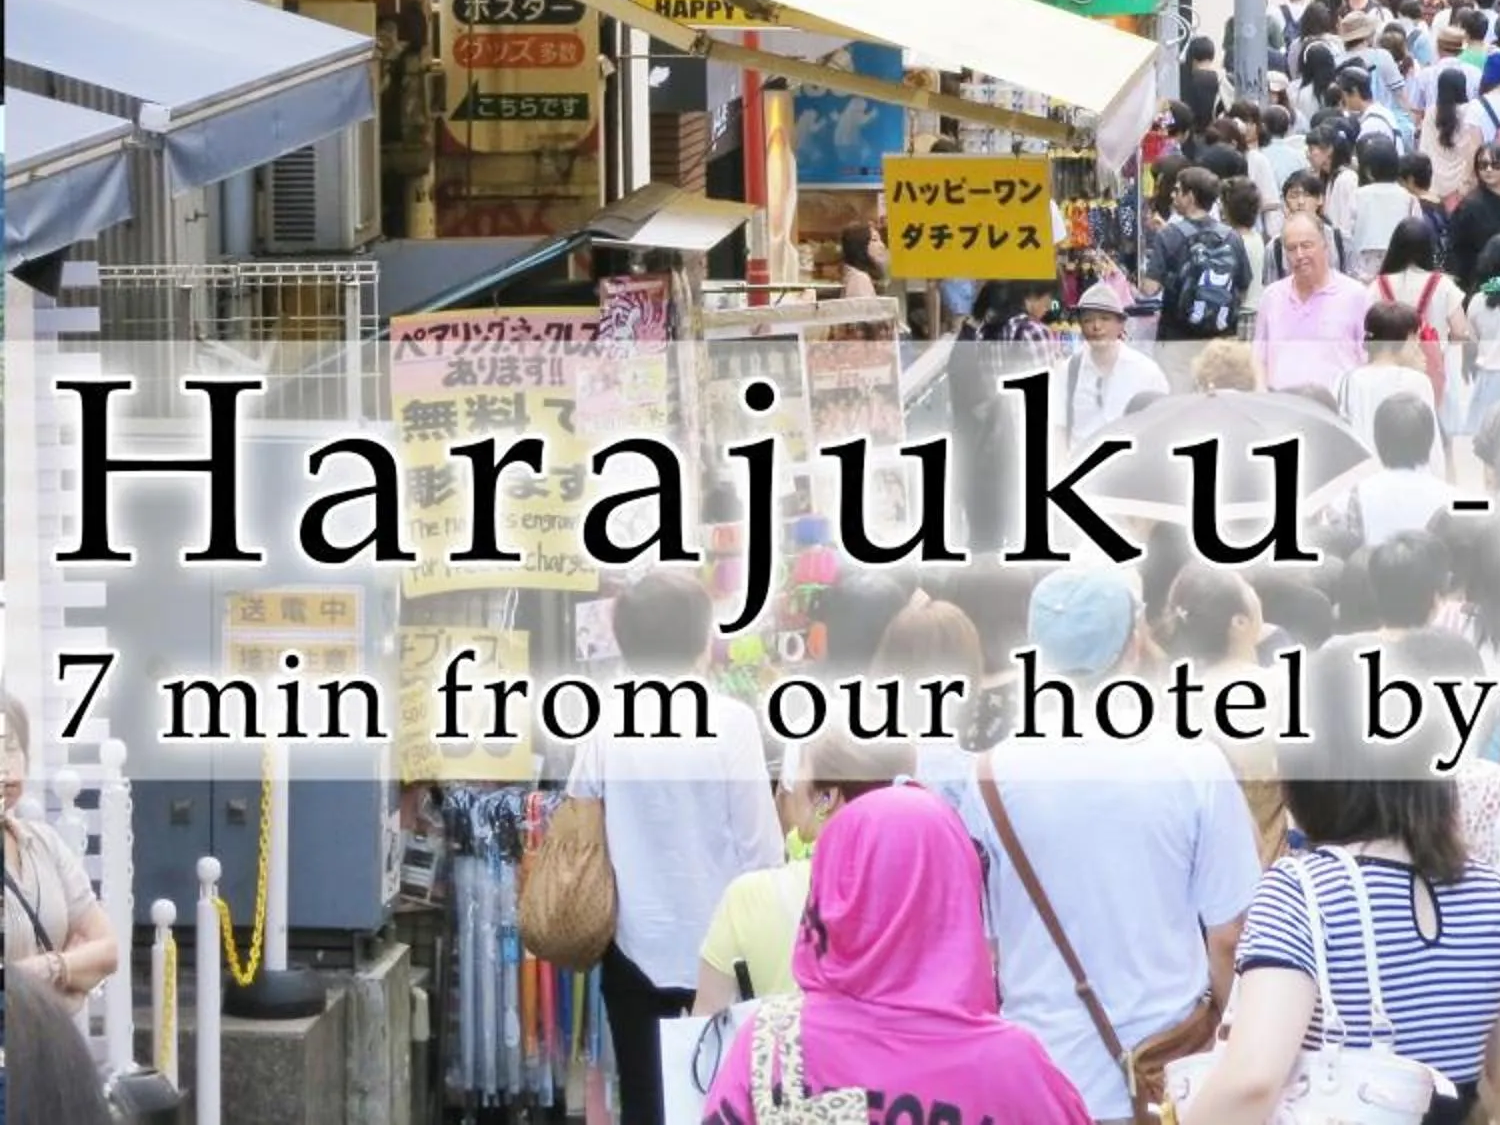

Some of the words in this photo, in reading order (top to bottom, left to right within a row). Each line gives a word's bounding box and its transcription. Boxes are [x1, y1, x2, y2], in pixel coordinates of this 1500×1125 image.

[476, 97, 581, 117] こちらです
[892, 176, 1044, 206] ハッピーワン
[239, 597, 347, 624] 送電中
